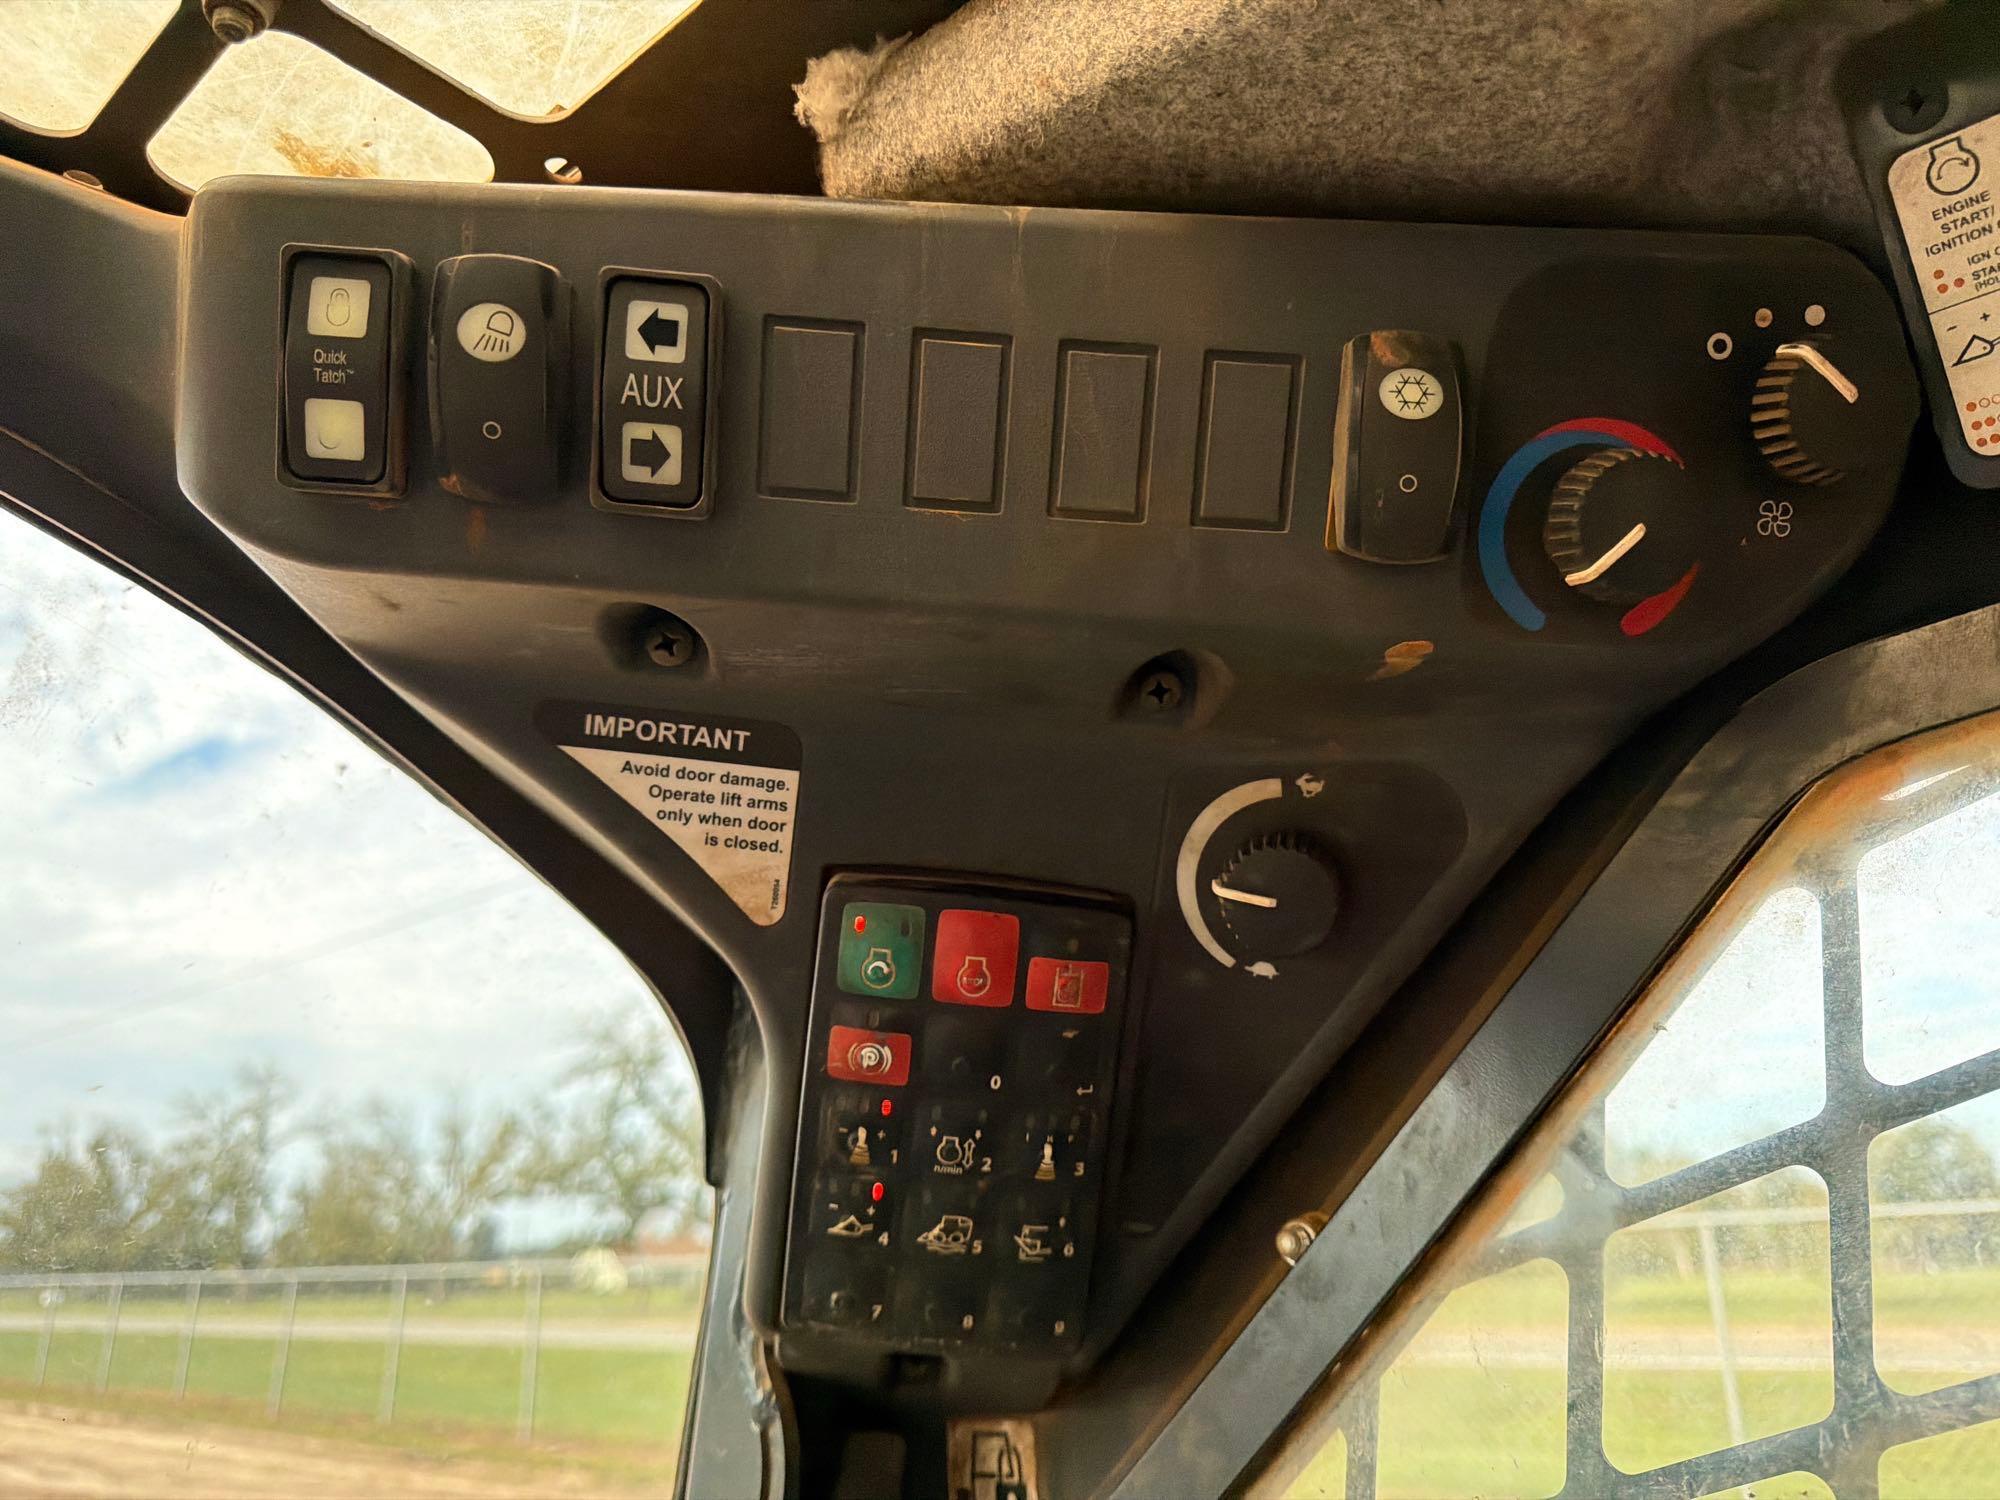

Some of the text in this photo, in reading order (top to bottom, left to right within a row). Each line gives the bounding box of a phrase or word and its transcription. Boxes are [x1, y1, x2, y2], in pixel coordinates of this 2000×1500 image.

[1931, 190, 1991, 221] ENGINE
[1940, 204, 1996, 234] START/
[1925, 223, 1993, 257] IGNITION
[1967, 250, 1991, 266] IGN
[313, 348, 347, 365] Quick
[620, 372, 684, 409] AUX
[584, 713, 751, 752] IMPORTANT
[620, 760, 790, 792] Avoid door damage.
[648, 784, 788, 812] Operate lift arms
[656, 808, 787, 832] only when door
[704, 832, 784, 854] is closed.
[890, 1149, 899, 1164] 1
[981, 1156, 992, 1172] 2
[1074, 1161, 1085, 1177] 3
[878, 1230, 889, 1247] 4
[972, 1239, 983, 1255] 5
[872, 1304, 883, 1321] 7
